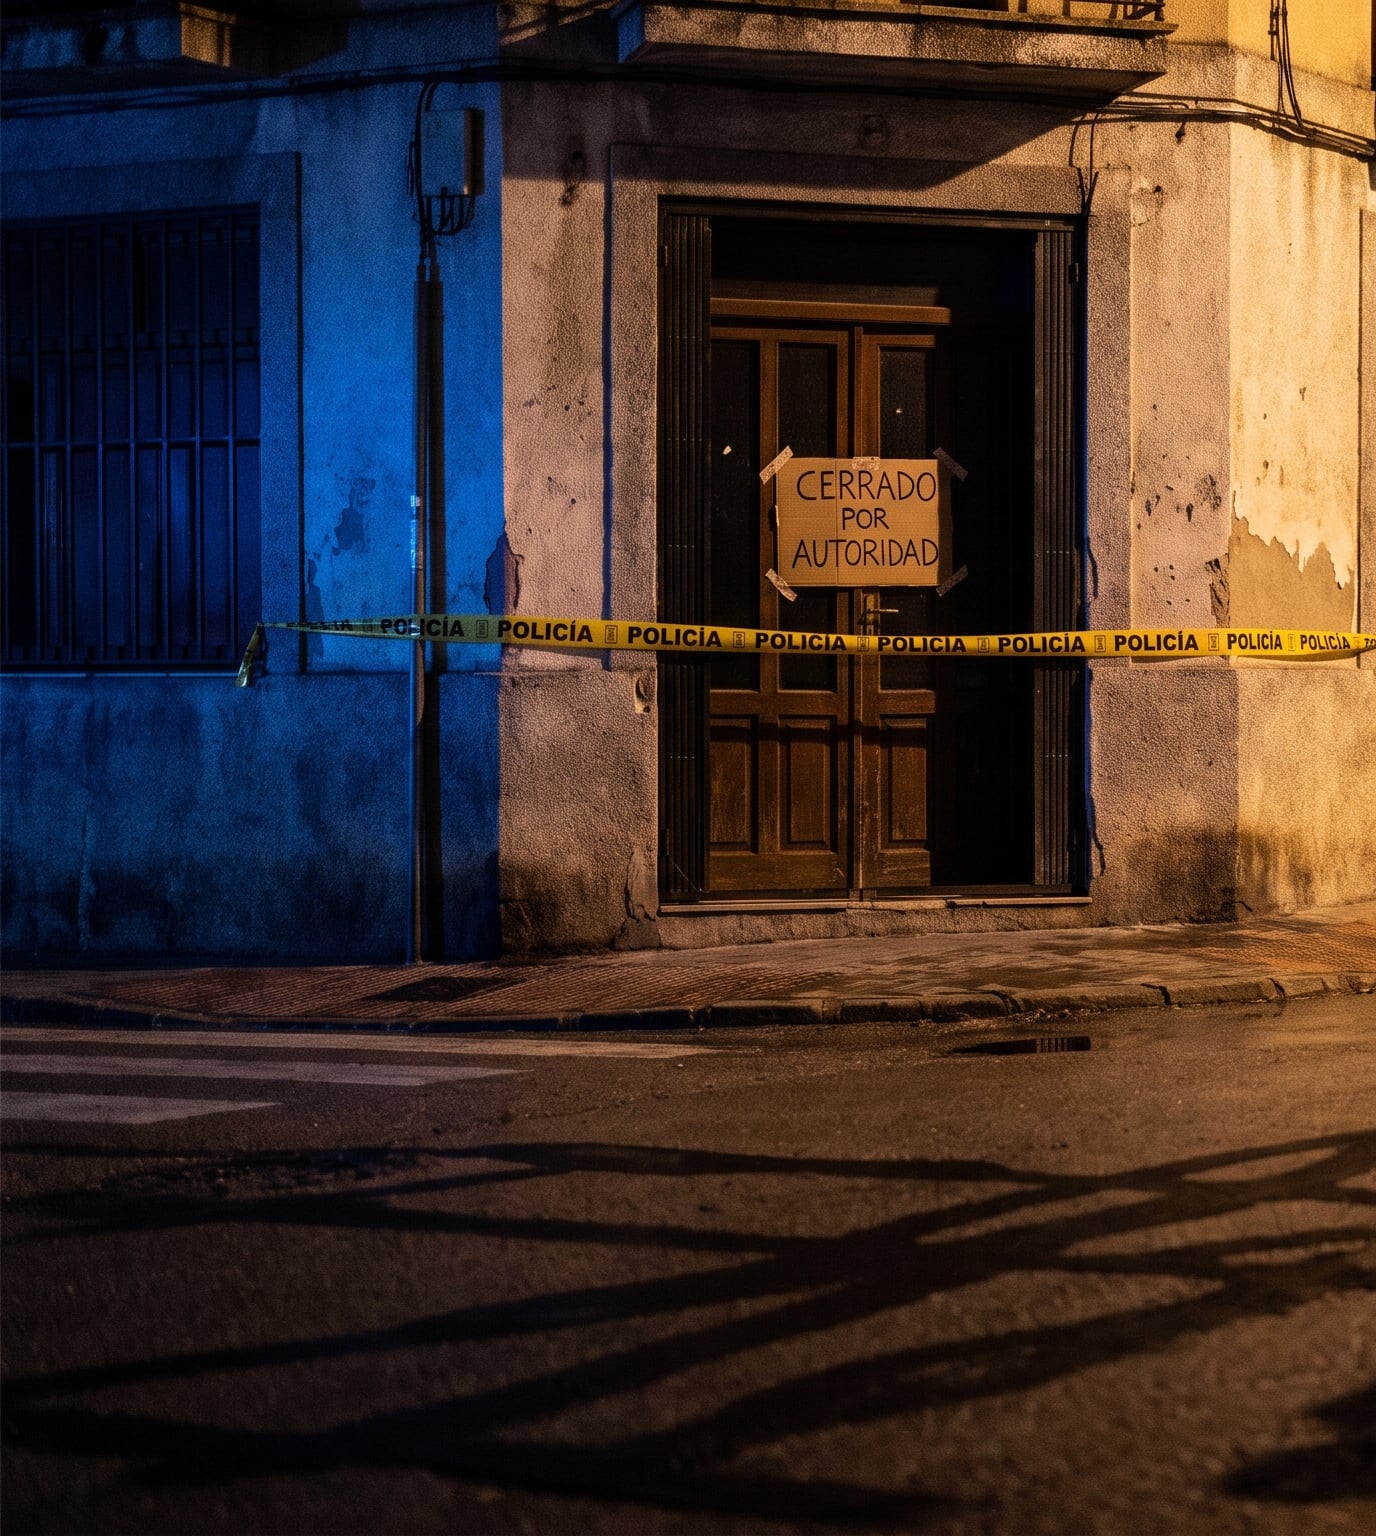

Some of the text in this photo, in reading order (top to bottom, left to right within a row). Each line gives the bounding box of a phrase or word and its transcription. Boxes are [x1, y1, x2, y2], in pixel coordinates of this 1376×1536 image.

[796, 470, 937, 502] CERRADO
[842, 507, 889, 530] POR
[791, 539, 939, 569] AUTORIDAD
[498, 620, 593, 643] POLICÍA
[628, 626, 721, 648] POLICÍA
[998, 633, 1086, 653] POLICÍA
[1115, 630, 1199, 651] POLICÍA
[1227, 630, 1283, 650] POLICÍA
[1300, 633, 1351, 650] POLICÍA
